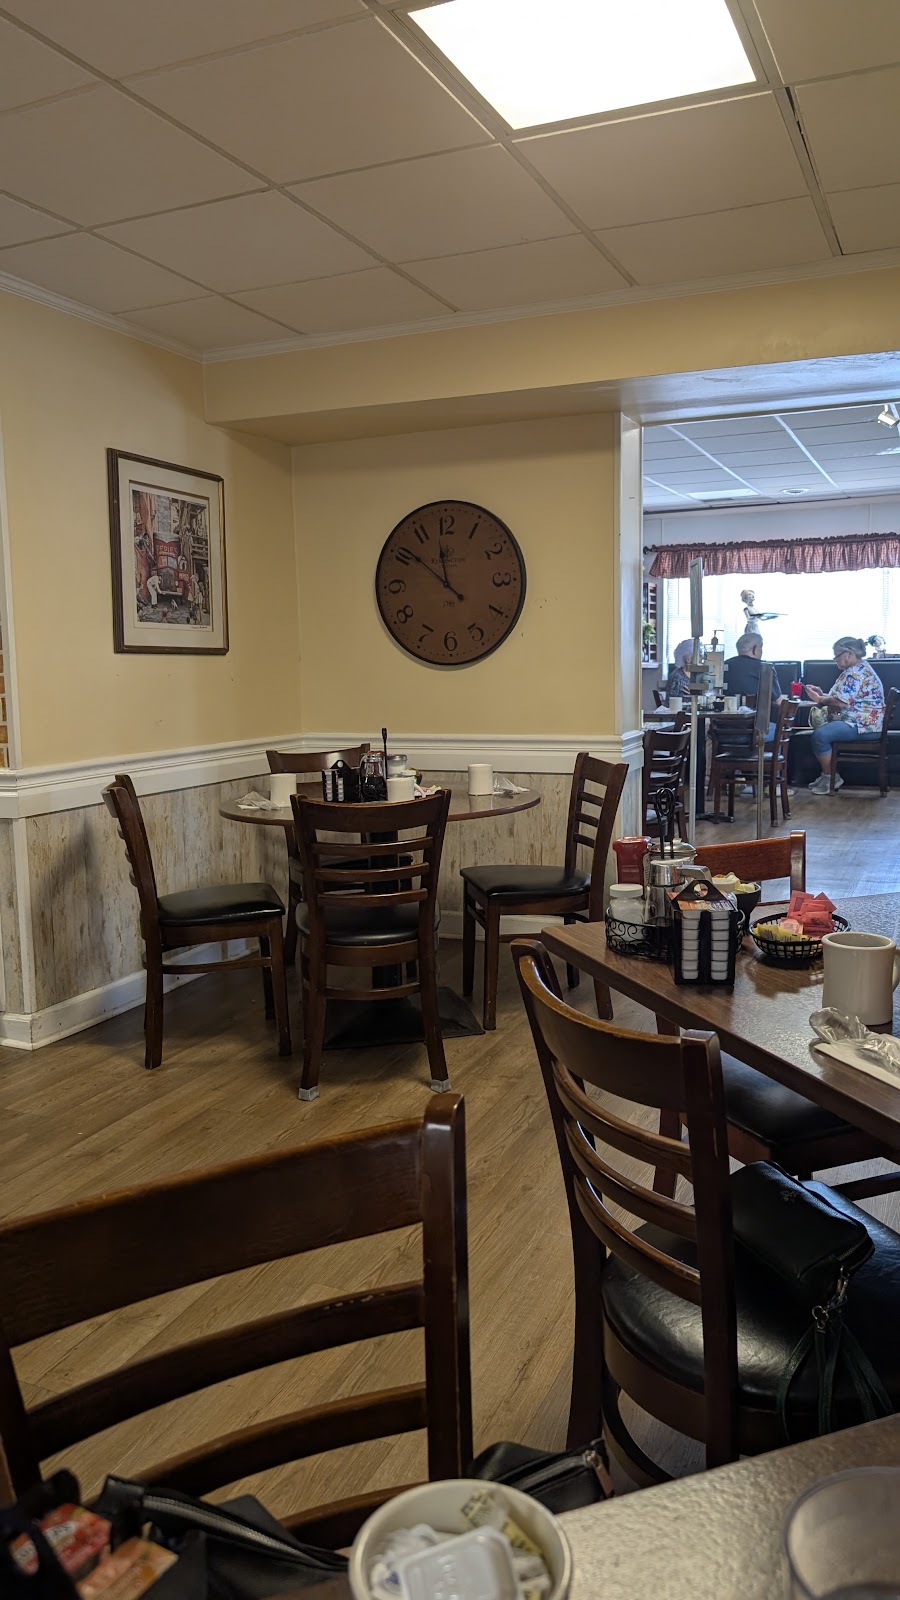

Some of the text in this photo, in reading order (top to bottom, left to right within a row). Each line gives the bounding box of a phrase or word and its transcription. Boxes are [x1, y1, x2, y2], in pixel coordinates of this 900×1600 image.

[413, 523, 430, 545] 11
[439, 515, 455, 536] 12
[468, 522, 480, 540] 1
[395, 546, 414, 567] 10
[484, 542, 503, 561] 2
[388, 578, 407, 595] 9
[492, 572, 512, 588] 3
[396, 604, 414, 624] 8
[488, 603, 504, 622] 4
[418, 623, 434, 643] 7
[443, 630, 458, 652] 6
[467, 622, 485, 642] 5
